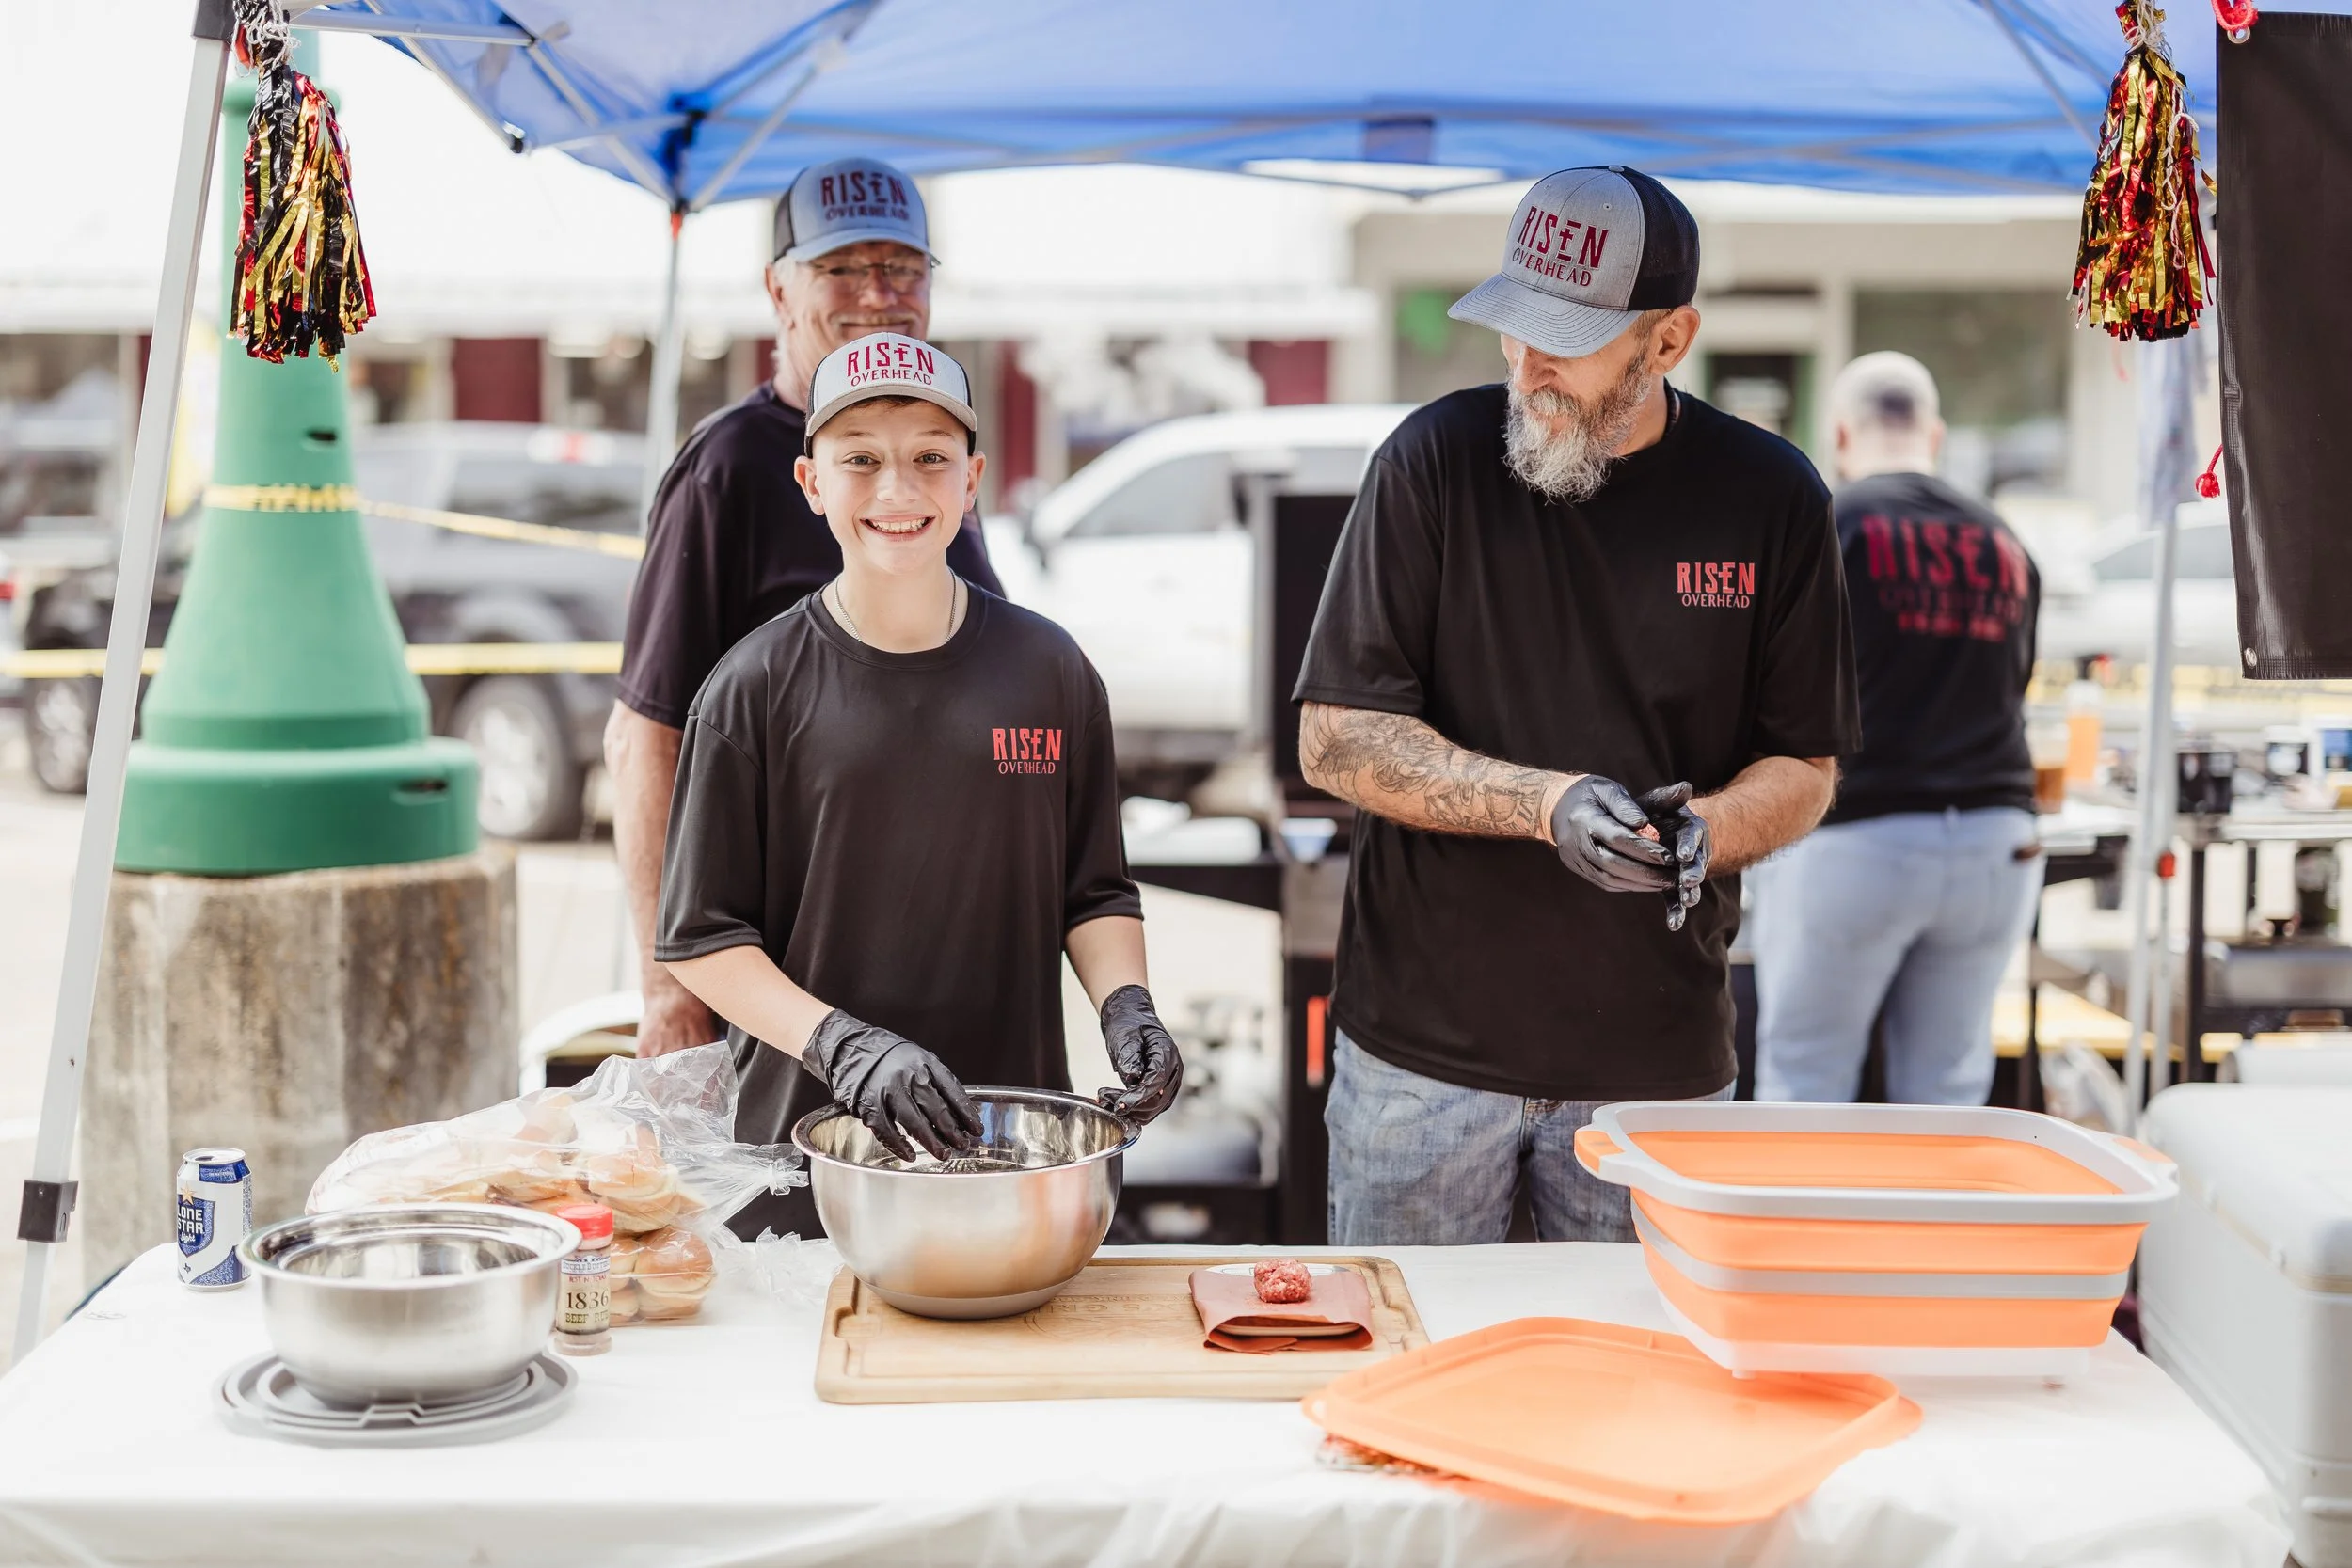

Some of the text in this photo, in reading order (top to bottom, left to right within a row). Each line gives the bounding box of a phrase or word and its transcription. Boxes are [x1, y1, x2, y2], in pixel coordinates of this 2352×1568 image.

[820, 170, 908, 206] RISEN
[825, 204, 910, 221] OVERHEAD
[1517, 205, 1610, 269] RISEN
[1512, 247, 1593, 287] OVERHEAD
[847, 341, 934, 376] RISEN
[850, 368, 932, 387] OVERHEAD
[1861, 515, 2028, 598] RISEN
[1677, 562, 1756, 594] RISEN
[1681, 594, 1750, 609] OVERHEAD
[992, 728, 1062, 760] RISEN
[998, 761, 1056, 774] OVERHEAD
[178, 1218, 204, 1234] STAR
[566, 1289, 609, 1309] 1836
[565, 1312, 589, 1323] BEEF
